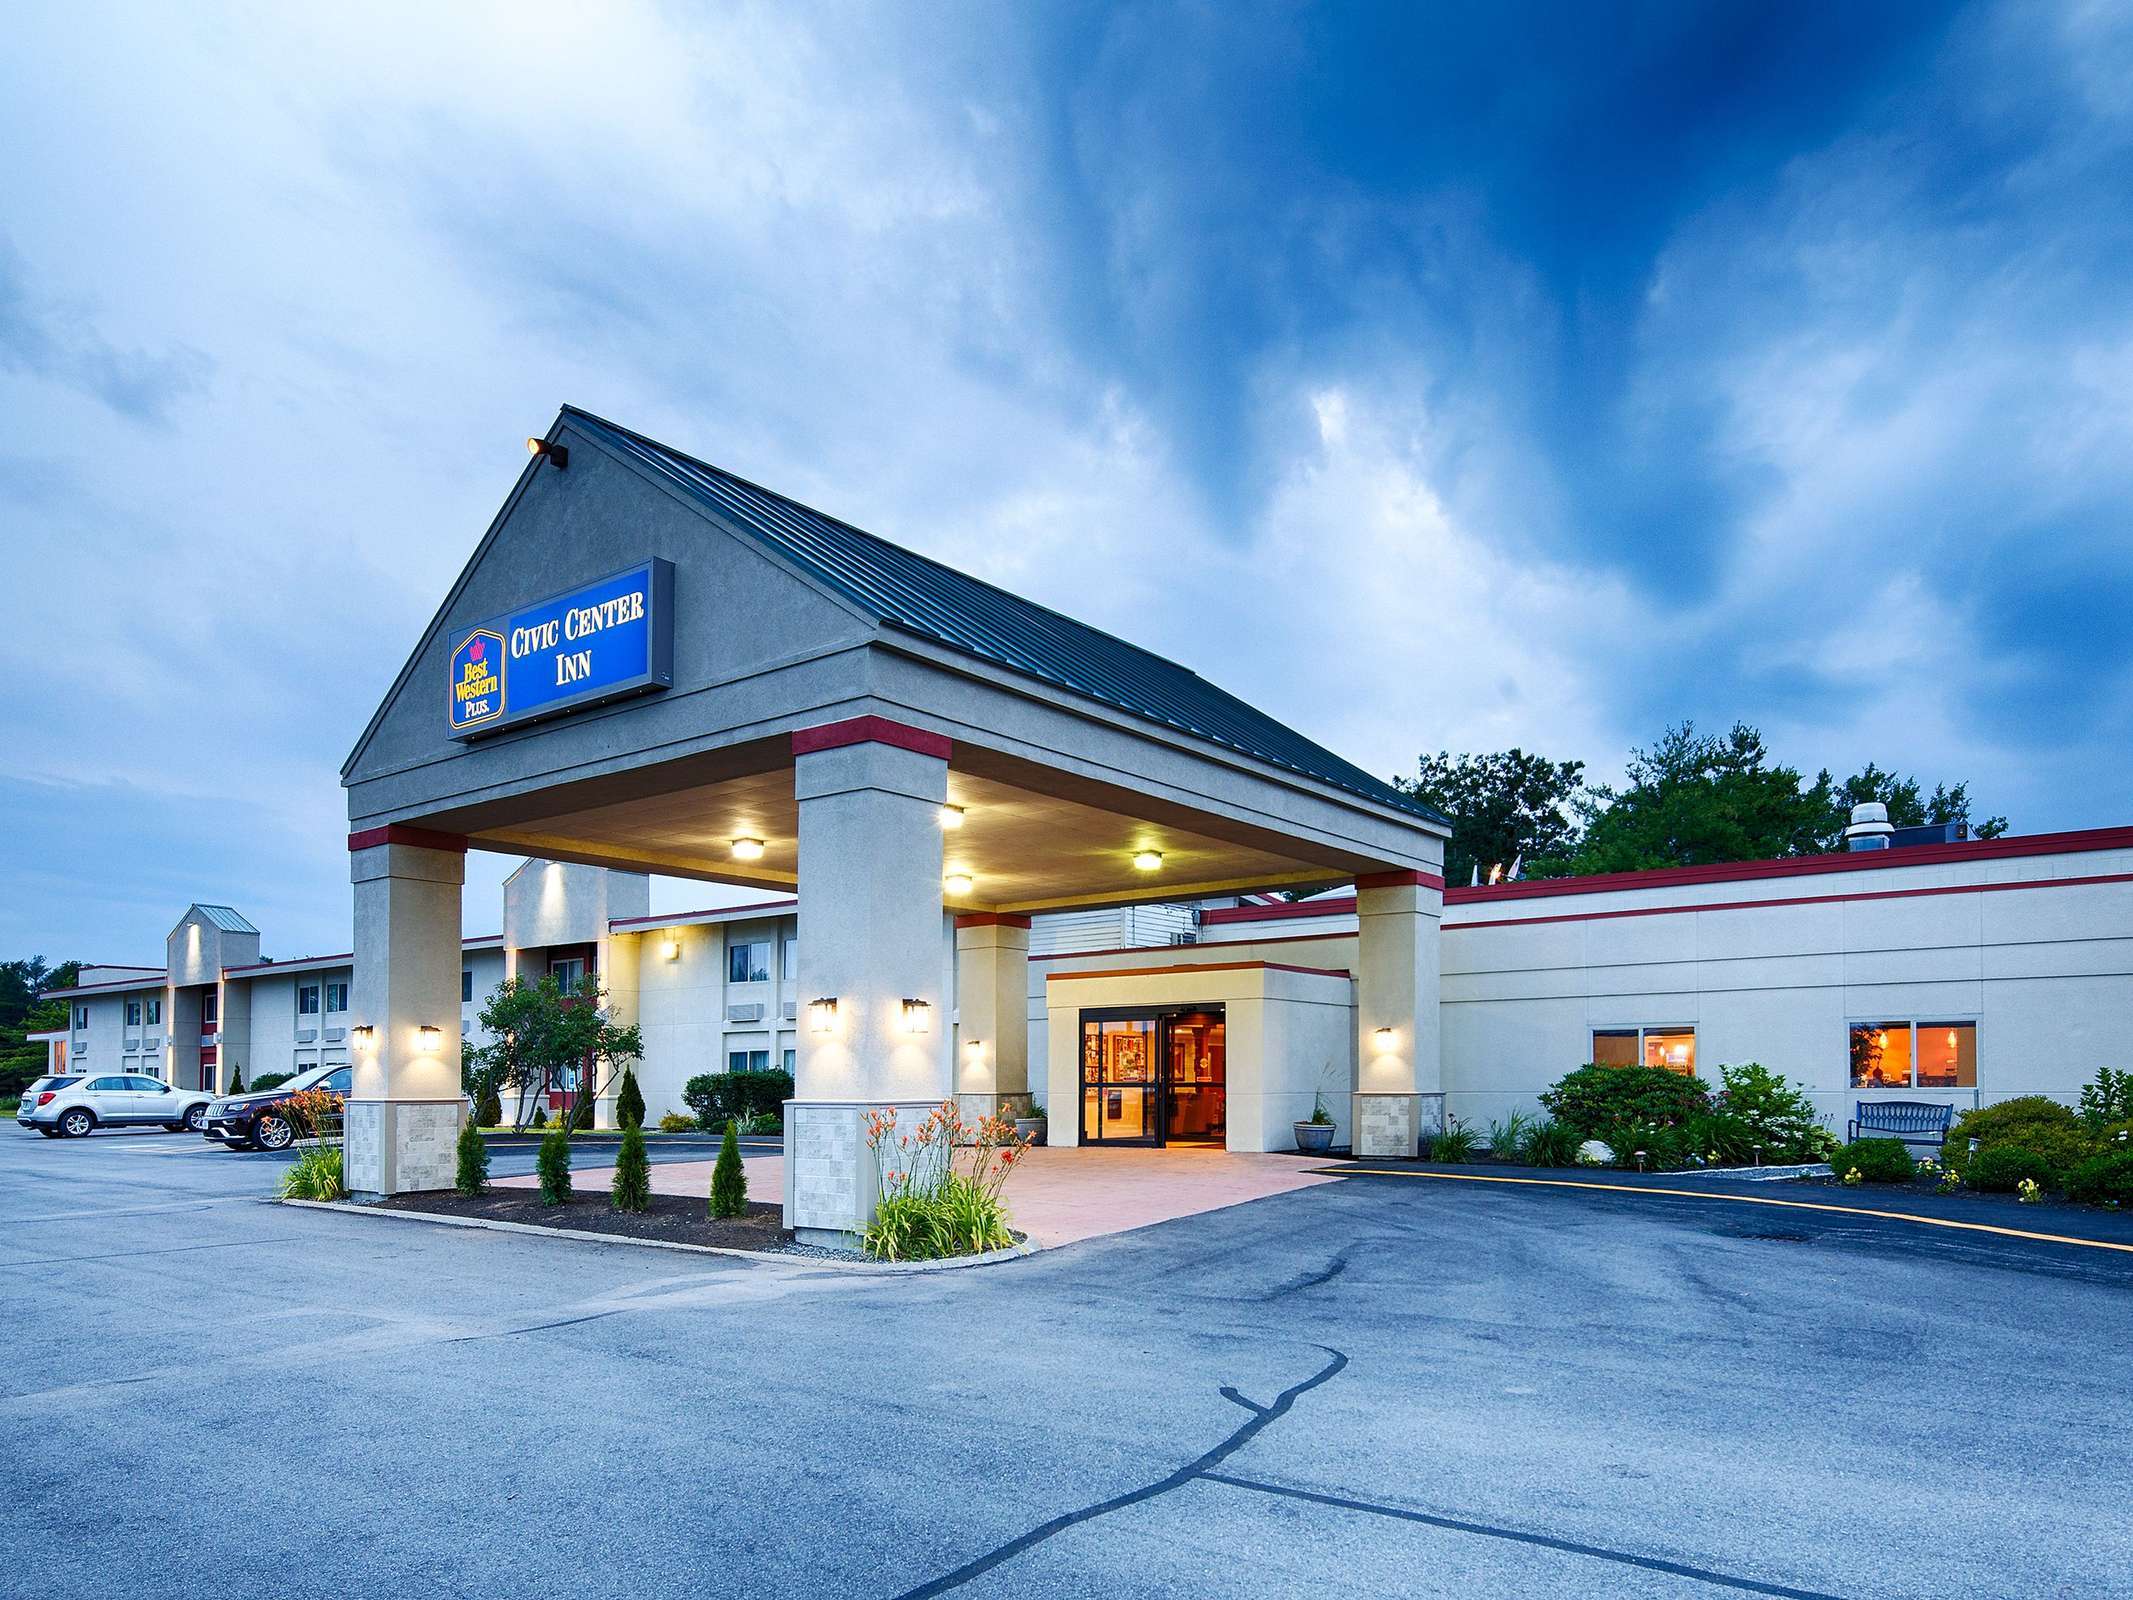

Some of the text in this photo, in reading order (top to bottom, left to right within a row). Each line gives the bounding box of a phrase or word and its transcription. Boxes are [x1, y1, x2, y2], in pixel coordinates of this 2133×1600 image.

[511, 591, 644, 658] CIVIC CENTER
[464, 658, 488, 682] Best
[555, 650, 592, 686] INN
[455, 676, 498, 703] Western
